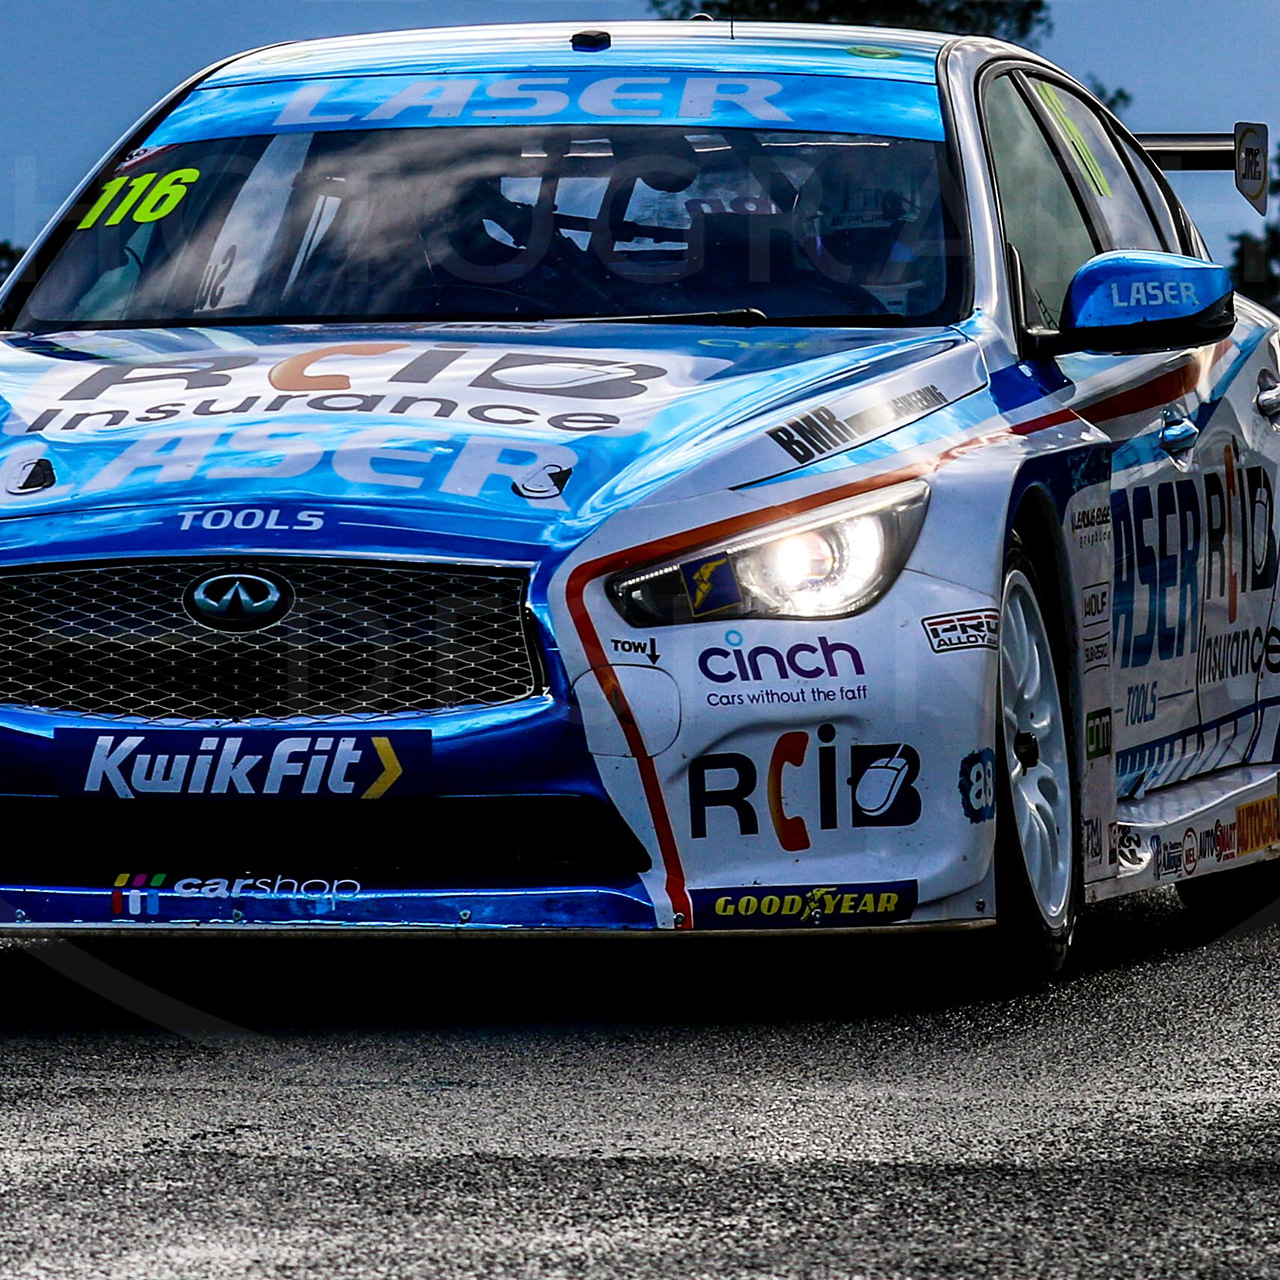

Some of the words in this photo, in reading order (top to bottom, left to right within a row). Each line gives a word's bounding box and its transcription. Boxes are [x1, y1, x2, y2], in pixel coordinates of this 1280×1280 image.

[272, 76, 794, 126] LASER
[76, 167, 199, 230] 116
[1110, 281, 1201, 307] LASER
[25, 389, 621, 433] Insurance
[764, 404, 856, 465] BMR
[177, 509, 326, 532] TOOLS
[610, 638, 648, 655] TOW
[697, 629, 866, 684] cinch
[706, 692, 744, 707] Cars
[749, 688, 807, 705] without
[811, 686, 837, 702] the
[839, 685, 868, 701] faff
[1125, 680, 1158, 727] TOOLS
[173, 874, 362, 911] carshop
